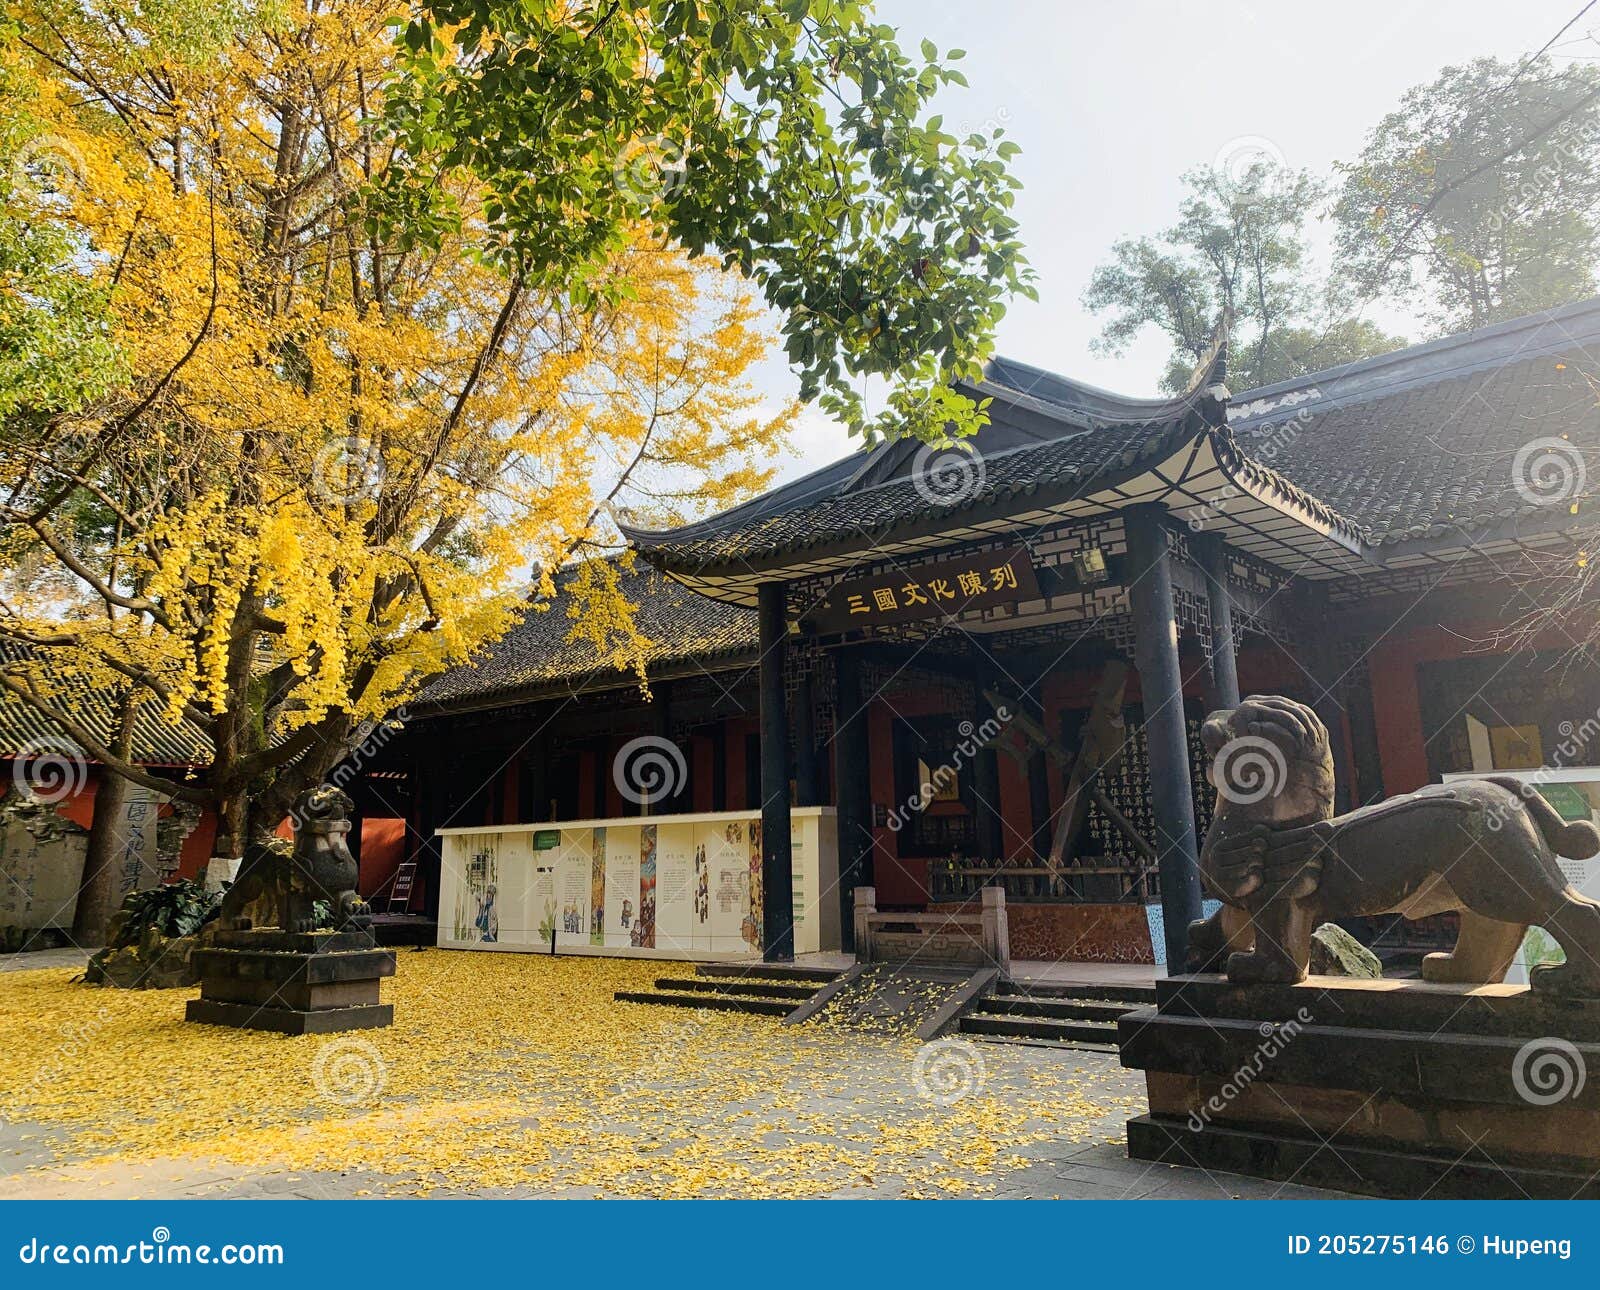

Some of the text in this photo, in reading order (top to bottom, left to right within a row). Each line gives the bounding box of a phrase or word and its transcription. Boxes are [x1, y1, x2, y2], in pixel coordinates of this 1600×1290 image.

[847, 564, 1018, 614] 三國文化陳列
